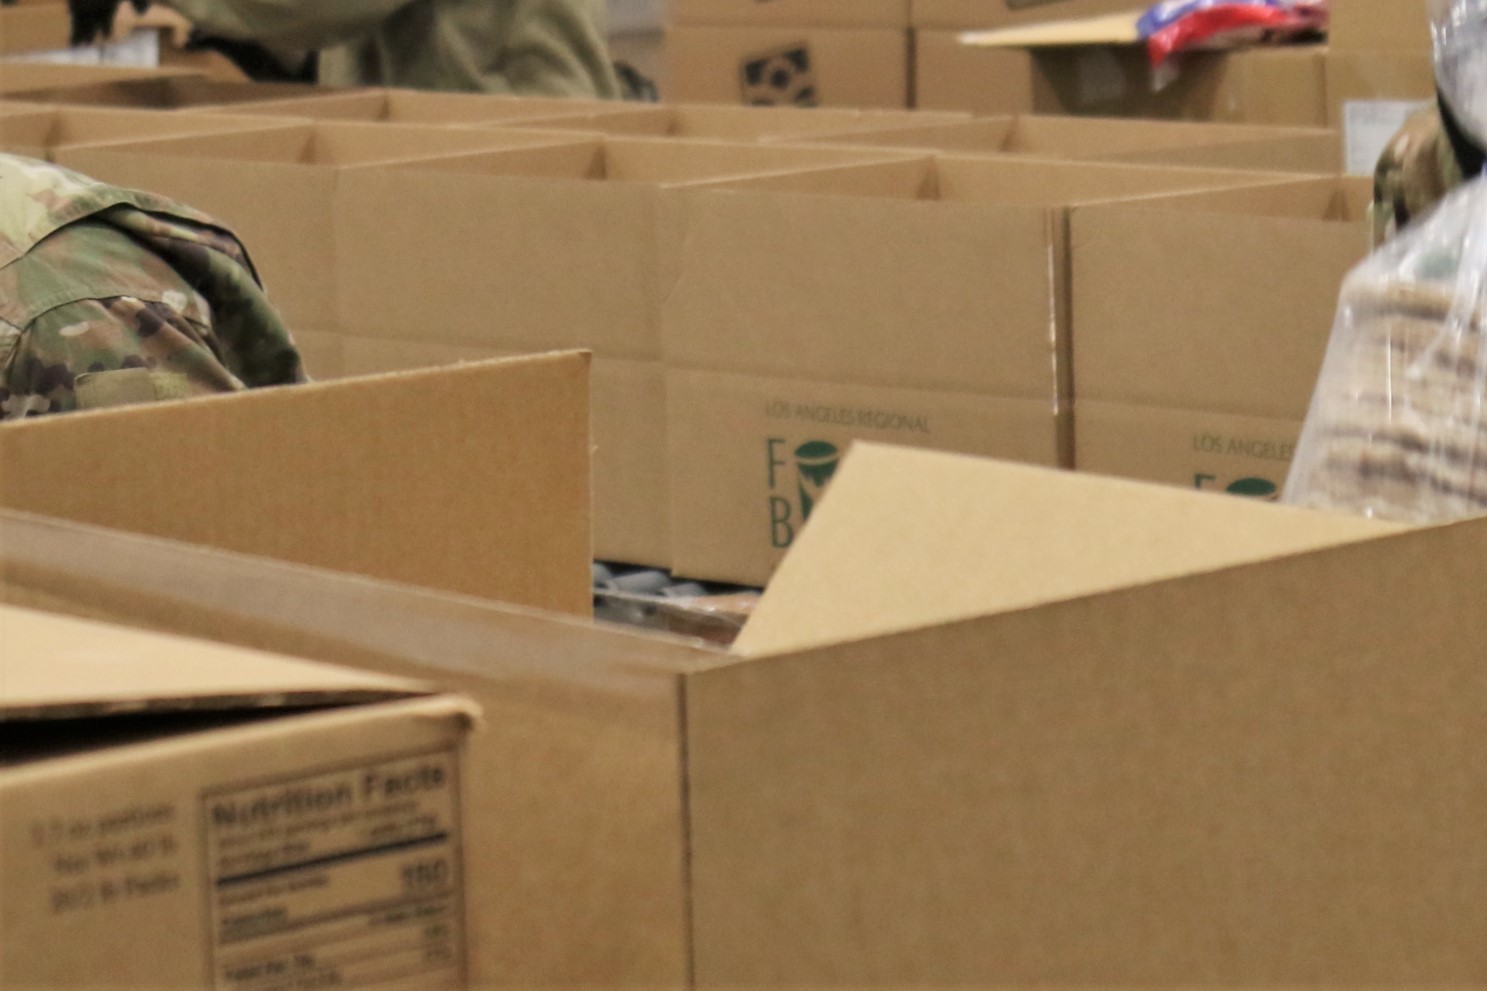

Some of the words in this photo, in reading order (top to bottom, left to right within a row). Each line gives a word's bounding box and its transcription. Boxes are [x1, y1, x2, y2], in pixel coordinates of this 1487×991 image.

[766, 399, 792, 419] LOS
[797, 403, 854, 427] ANGELES
[857, 408, 931, 434] REGIONAL
[1193, 432, 1222, 455] LOS
[211, 784, 353, 826] Nutrition
[361, 766, 445, 803] Facts
